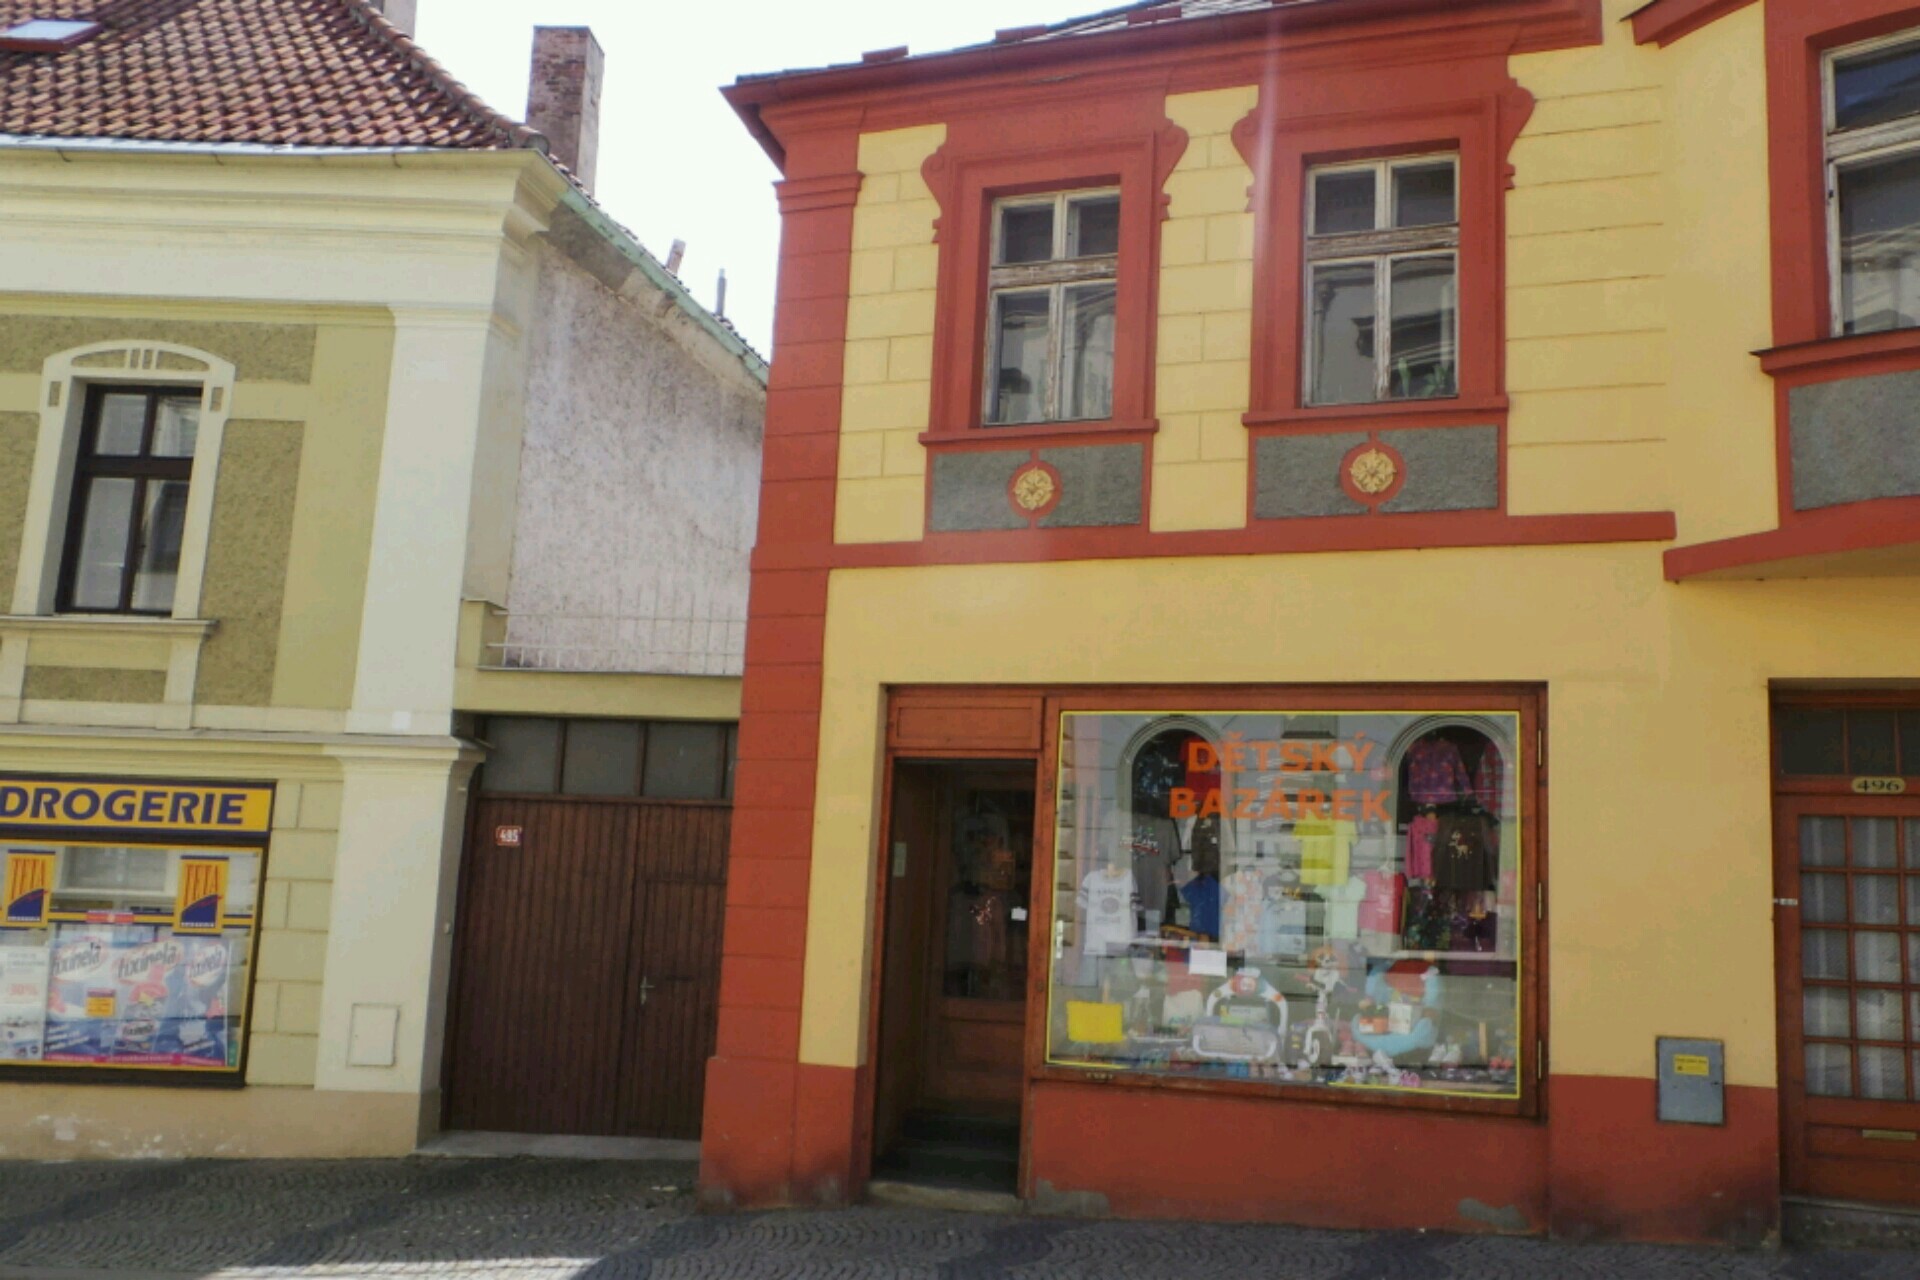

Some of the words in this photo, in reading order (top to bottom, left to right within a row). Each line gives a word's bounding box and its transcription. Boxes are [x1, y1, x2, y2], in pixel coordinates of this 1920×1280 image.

[1188, 731, 1375, 773] DĚTSKÝ
[0, 786, 247, 825] DROGERIE
[1169, 778, 1392, 822] BAZÁREK
[1856, 779, 1900, 792] 496
